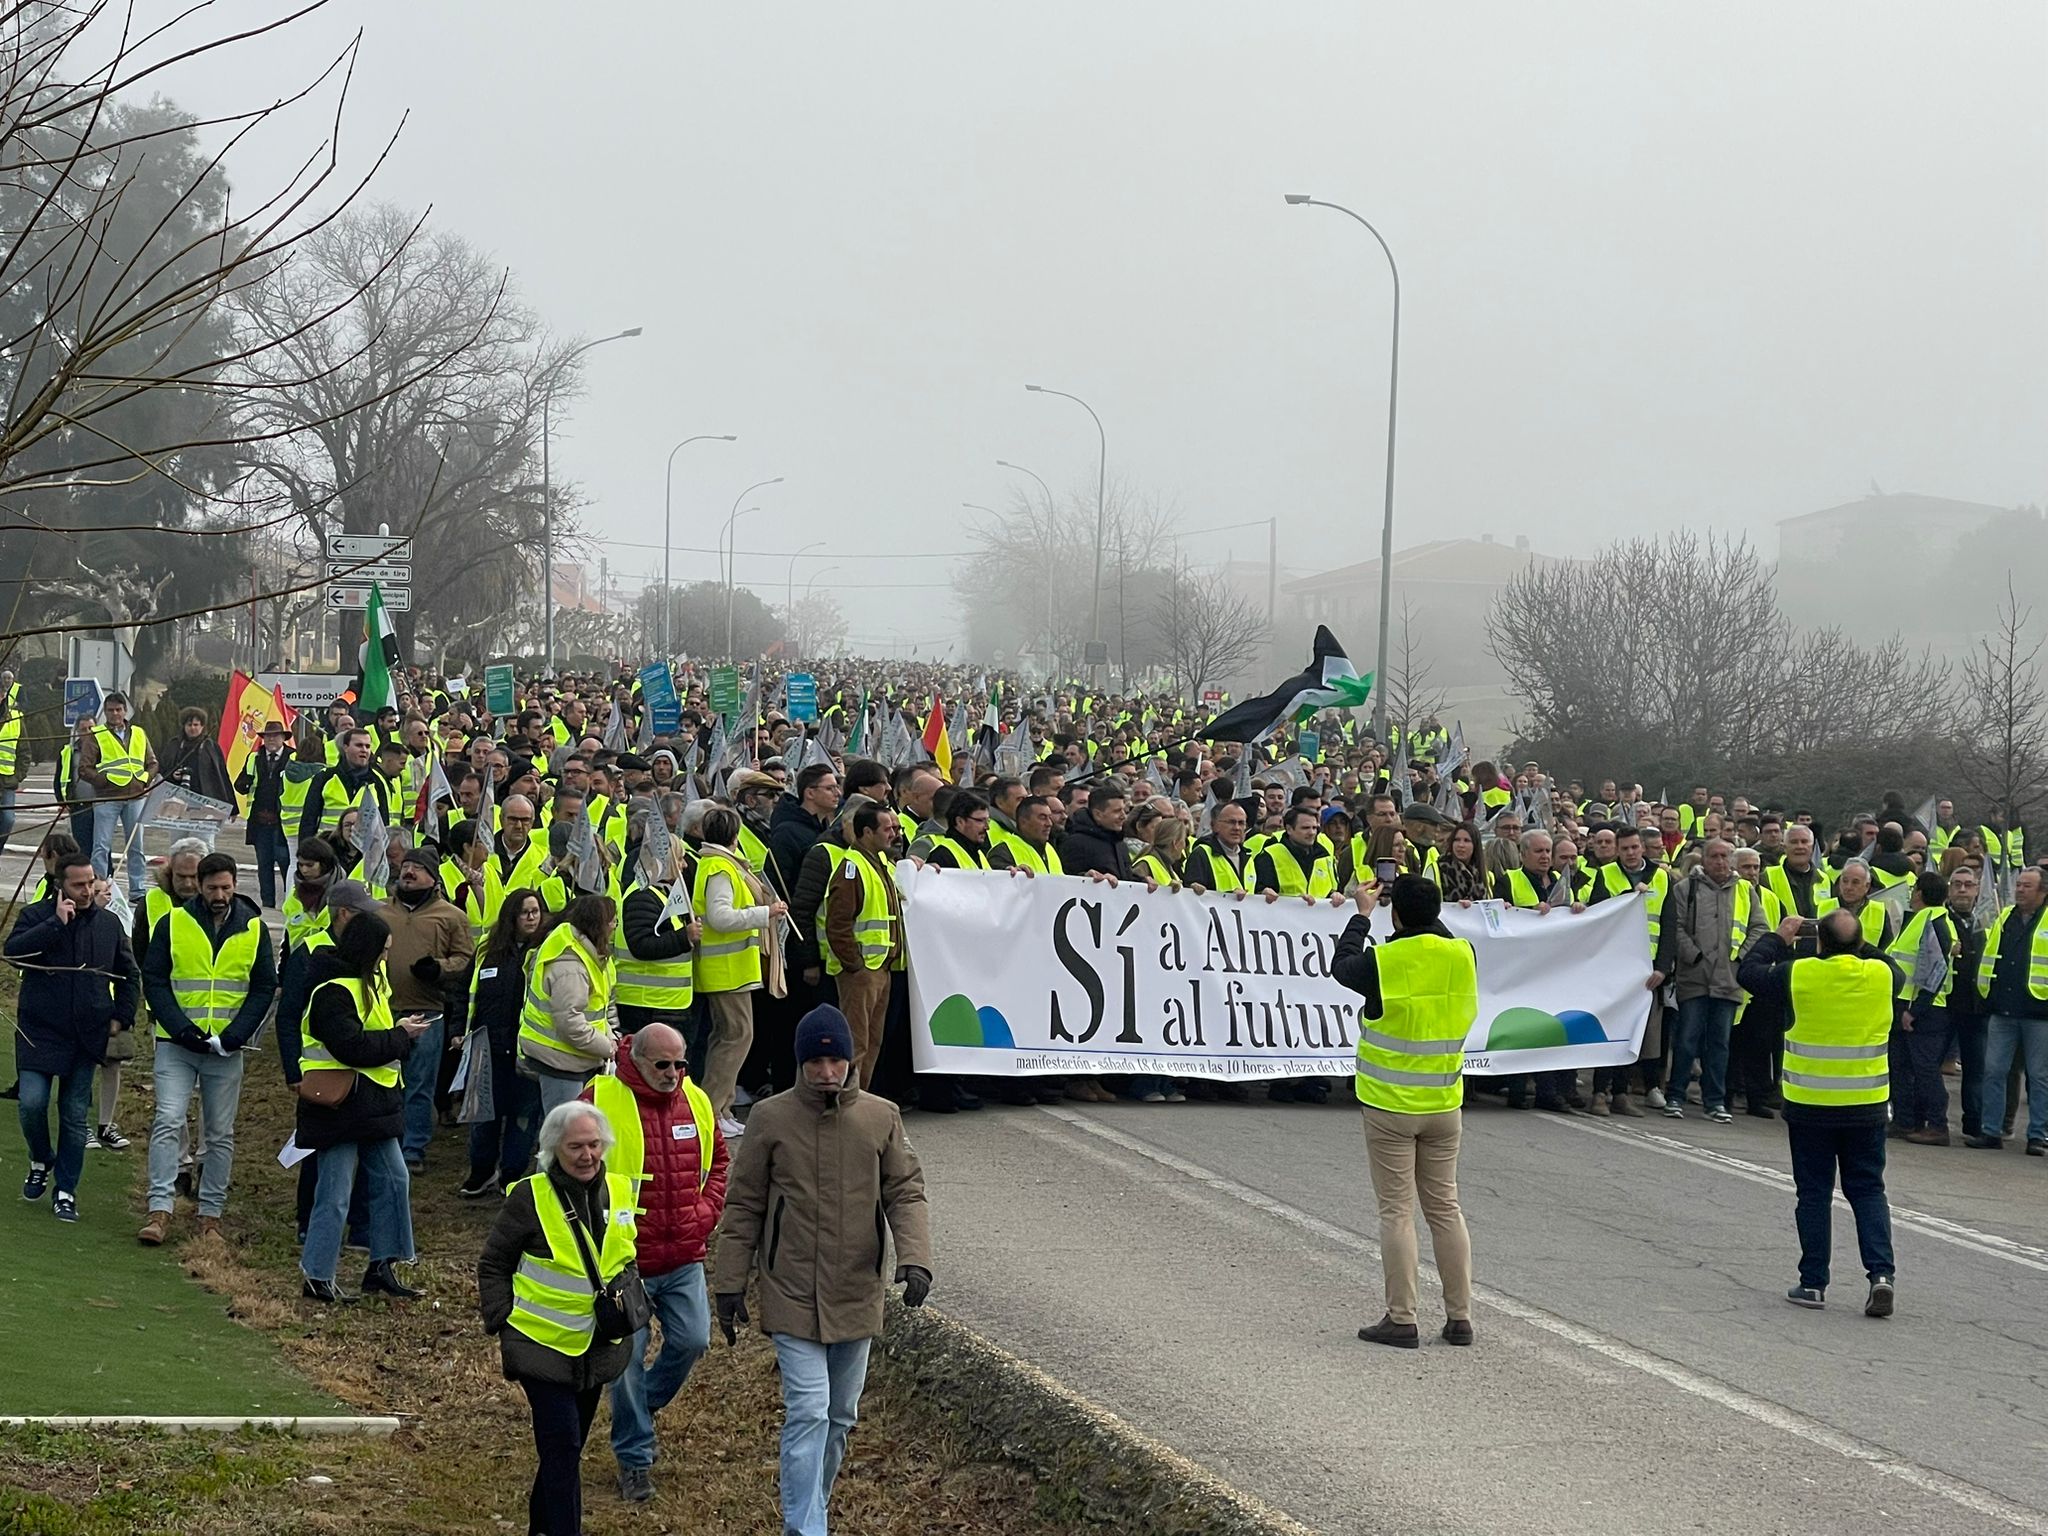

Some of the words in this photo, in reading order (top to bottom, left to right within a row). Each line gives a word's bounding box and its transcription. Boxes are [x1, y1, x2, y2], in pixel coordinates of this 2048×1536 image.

[393, 569, 407, 577] tiro
[1050, 897, 1143, 1044] Sí
[1159, 922, 1187, 972] a
[1203, 906, 1392, 978] Alma
[1163, 979, 1207, 1047] al
[1225, 980, 1365, 1049] futur
[1016, 1054, 1092, 1070] manifestación
[1097, 1056, 1136, 1072] sábado
[1137, 1057, 1151, 1072] 18
[1151, 1058, 1166, 1073] de
[1166, 1061, 1198, 1073] enero
[1199, 1062, 1206, 1074] a
[1207, 1059, 1223, 1074] las
[1227, 1059, 1239, 1074] 10
[1242, 1059, 1276, 1074] horas
[1283, 1060, 1316, 1076] plaza
[1317, 1060, 1337, 1073] del
